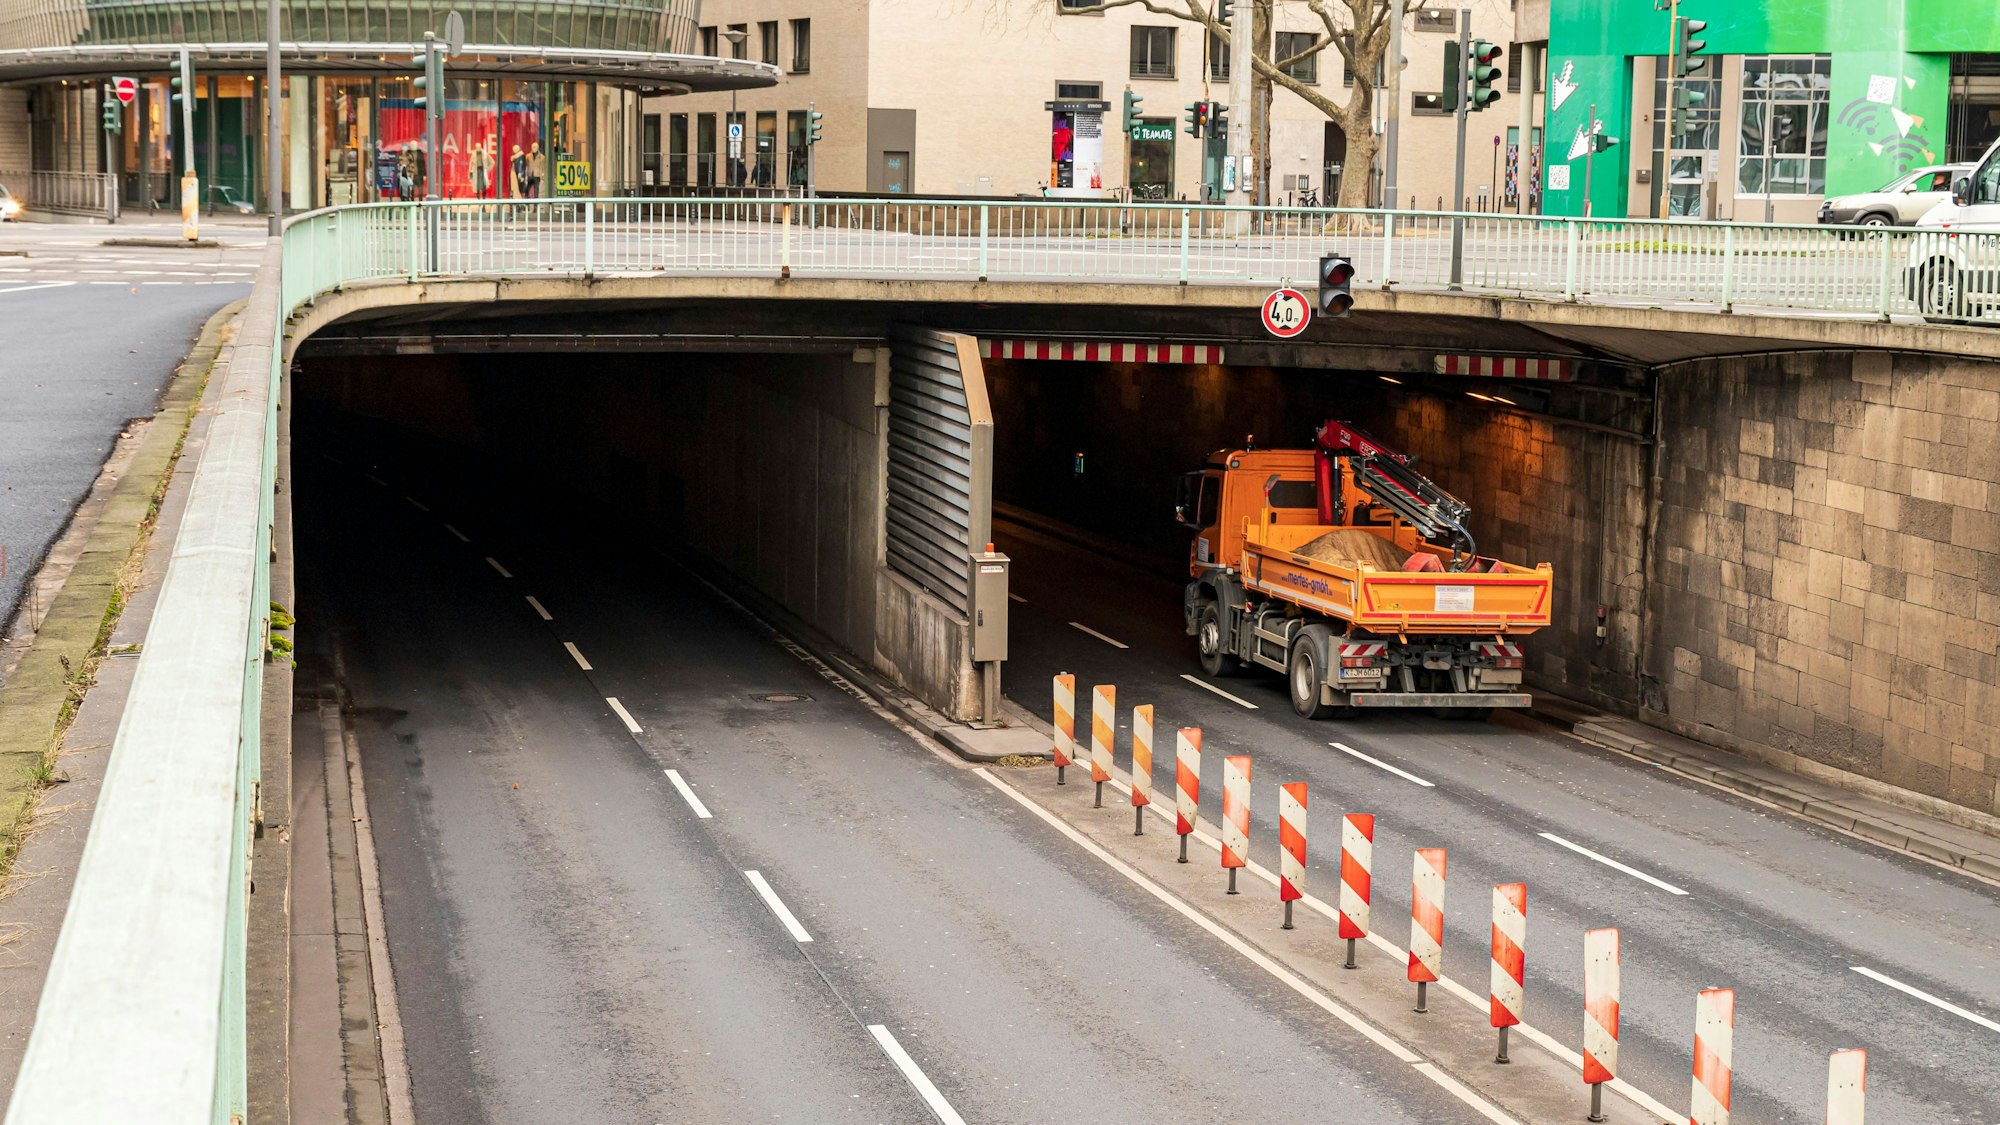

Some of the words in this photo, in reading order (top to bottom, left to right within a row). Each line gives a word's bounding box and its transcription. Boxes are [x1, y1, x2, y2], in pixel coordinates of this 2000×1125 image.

[1142, 128, 1172, 140] TEAMATE
[559, 165, 589, 186] 50%
[1271, 301, 1293, 323] 4,0
